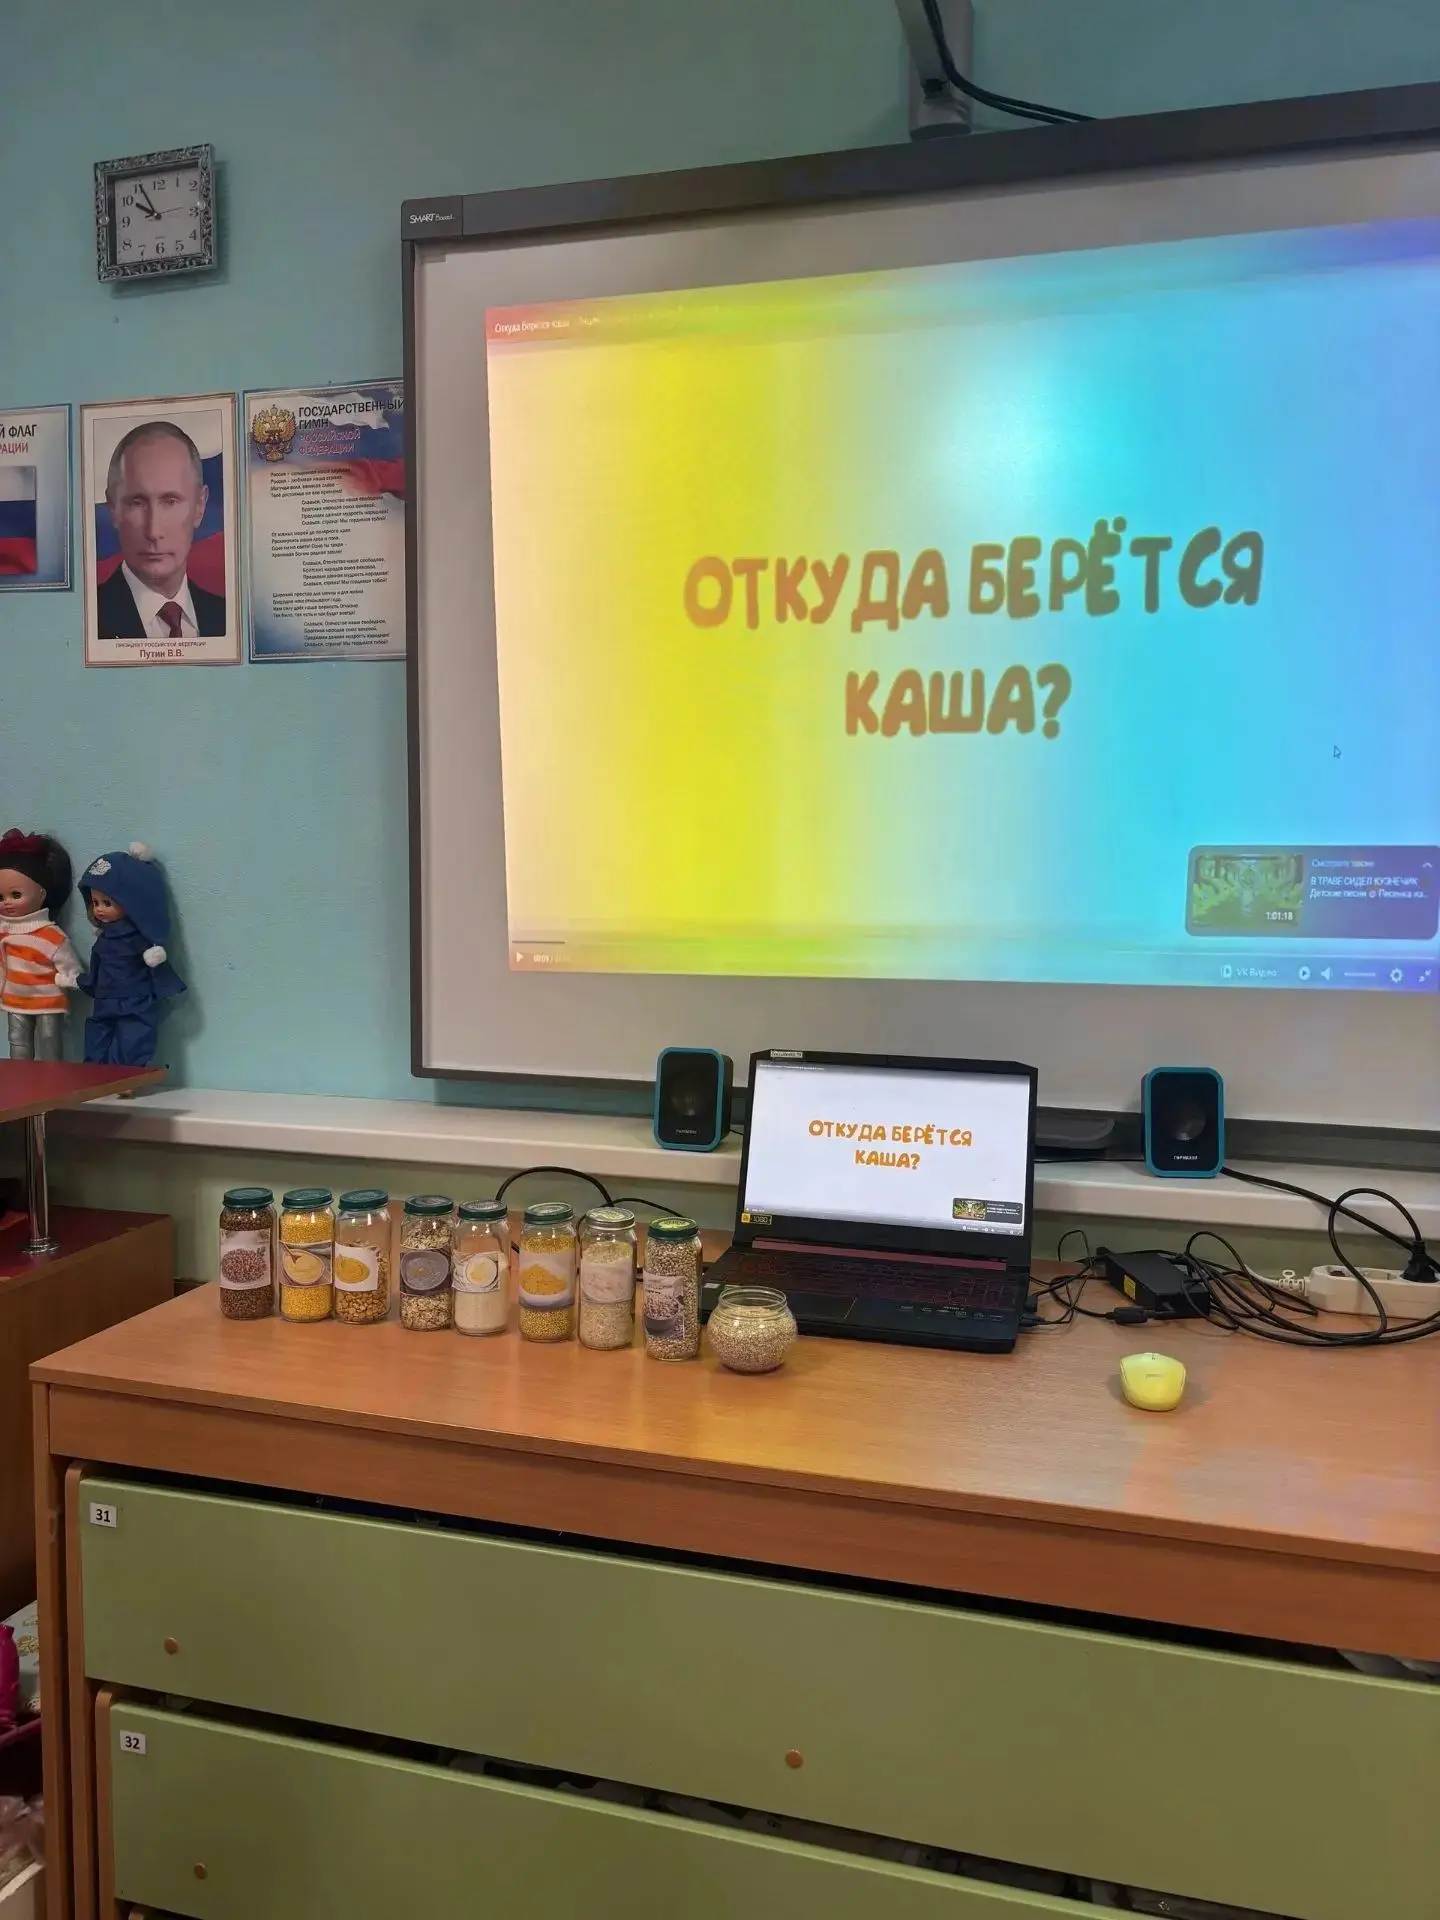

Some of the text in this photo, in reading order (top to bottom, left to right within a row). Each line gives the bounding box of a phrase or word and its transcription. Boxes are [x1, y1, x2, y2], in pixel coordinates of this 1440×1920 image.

[153, 179, 166, 191] 12
[188, 180, 198, 192] 2
[122, 195, 134, 207] 10
[189, 206, 199, 218] 3
[122, 216, 131, 228] 9
[409, 213, 435, 224] SMART
[188, 229, 198, 240] 4
[122, 239, 132, 251] 8
[138, 244, 147, 256] 7
[155, 242, 165, 254] 6
[175, 240, 185, 252] 5
[298, 417, 329, 430] ГИМН
[8, 424, 38, 438] ФЛАГ
[684, 515, 1265, 634] ОТКУДА БЕРЁТСЯ
[140, 649, 185, 660] Путин В.В.
[844, 662, 1072, 740] КАША?
[808, 1120, 972, 1146] ОТКУДА БЕРЁТСЯ
[855, 1150, 921, 1170] КАША?
[95, 1508, 111, 1523] 31
[125, 1736, 140, 1750] 32
